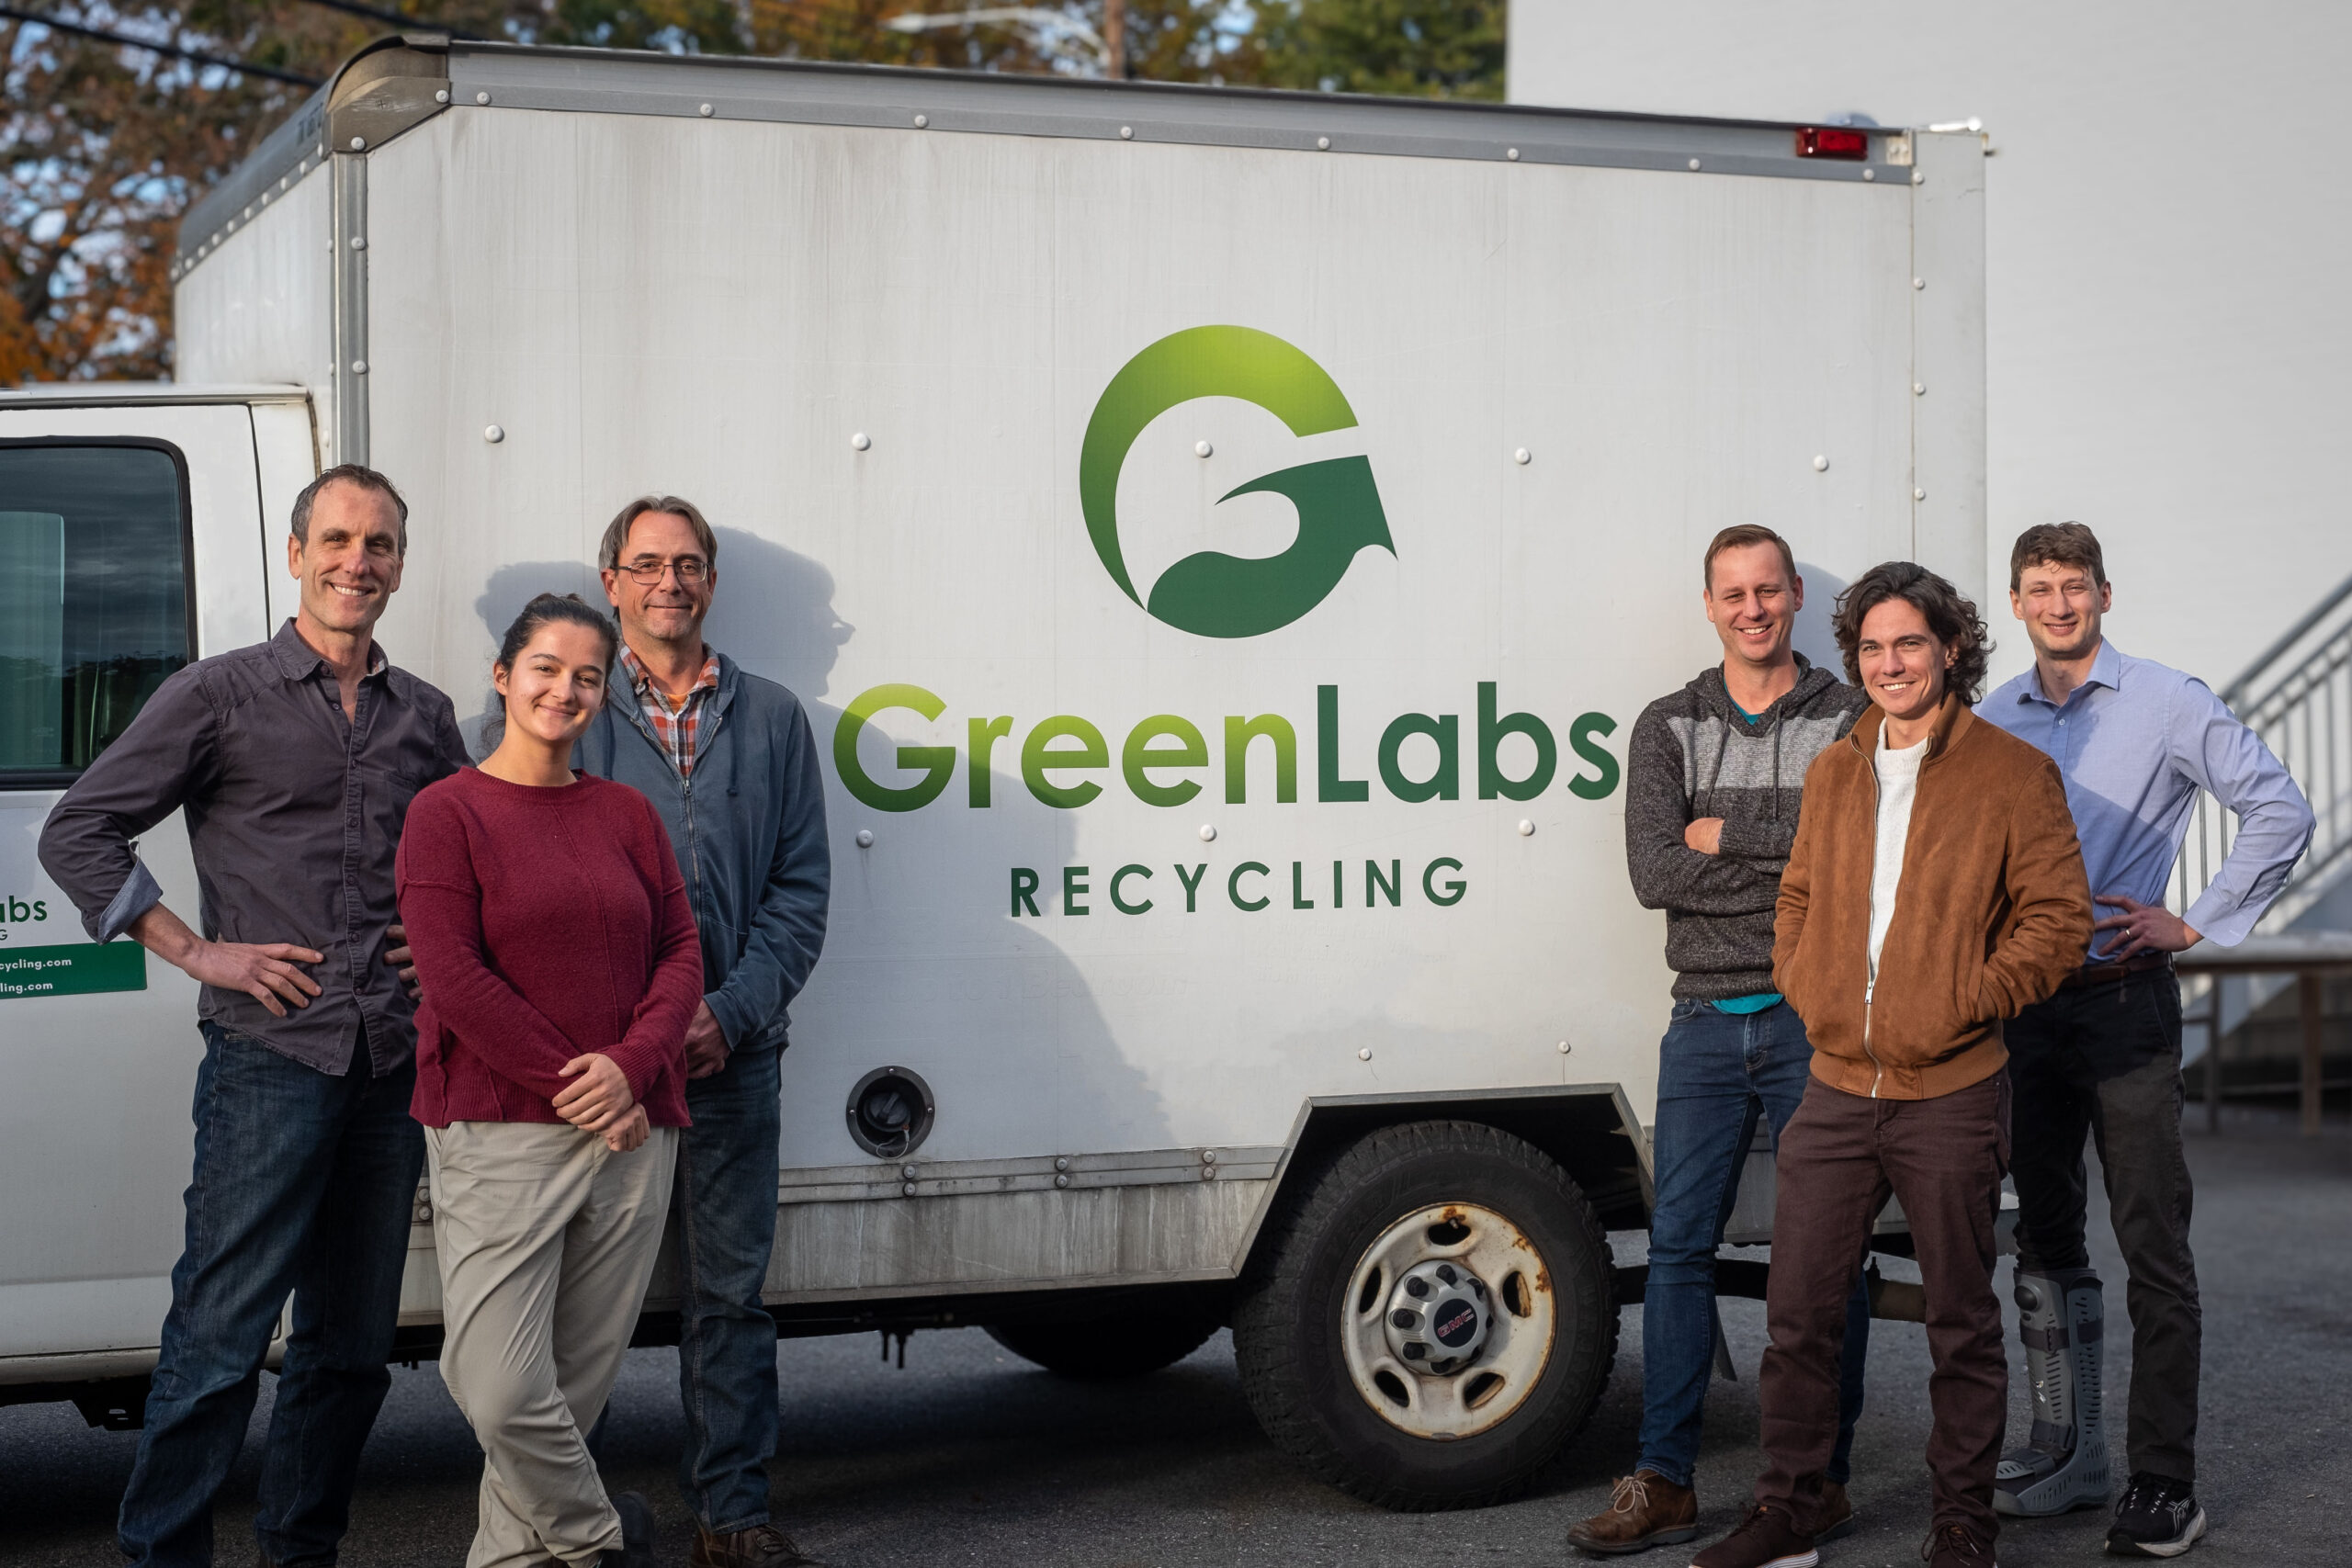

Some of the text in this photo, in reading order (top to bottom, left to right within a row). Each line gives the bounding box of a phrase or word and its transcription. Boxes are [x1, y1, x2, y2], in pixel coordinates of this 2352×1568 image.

[833, 681, 1620, 812] GreenLabs
[1011, 857, 1467, 917] RECYCLING
[0, 895, 48, 923] bs
[0, 982, 53, 994] ling.com
[1437, 1308, 1476, 1337] GMC
